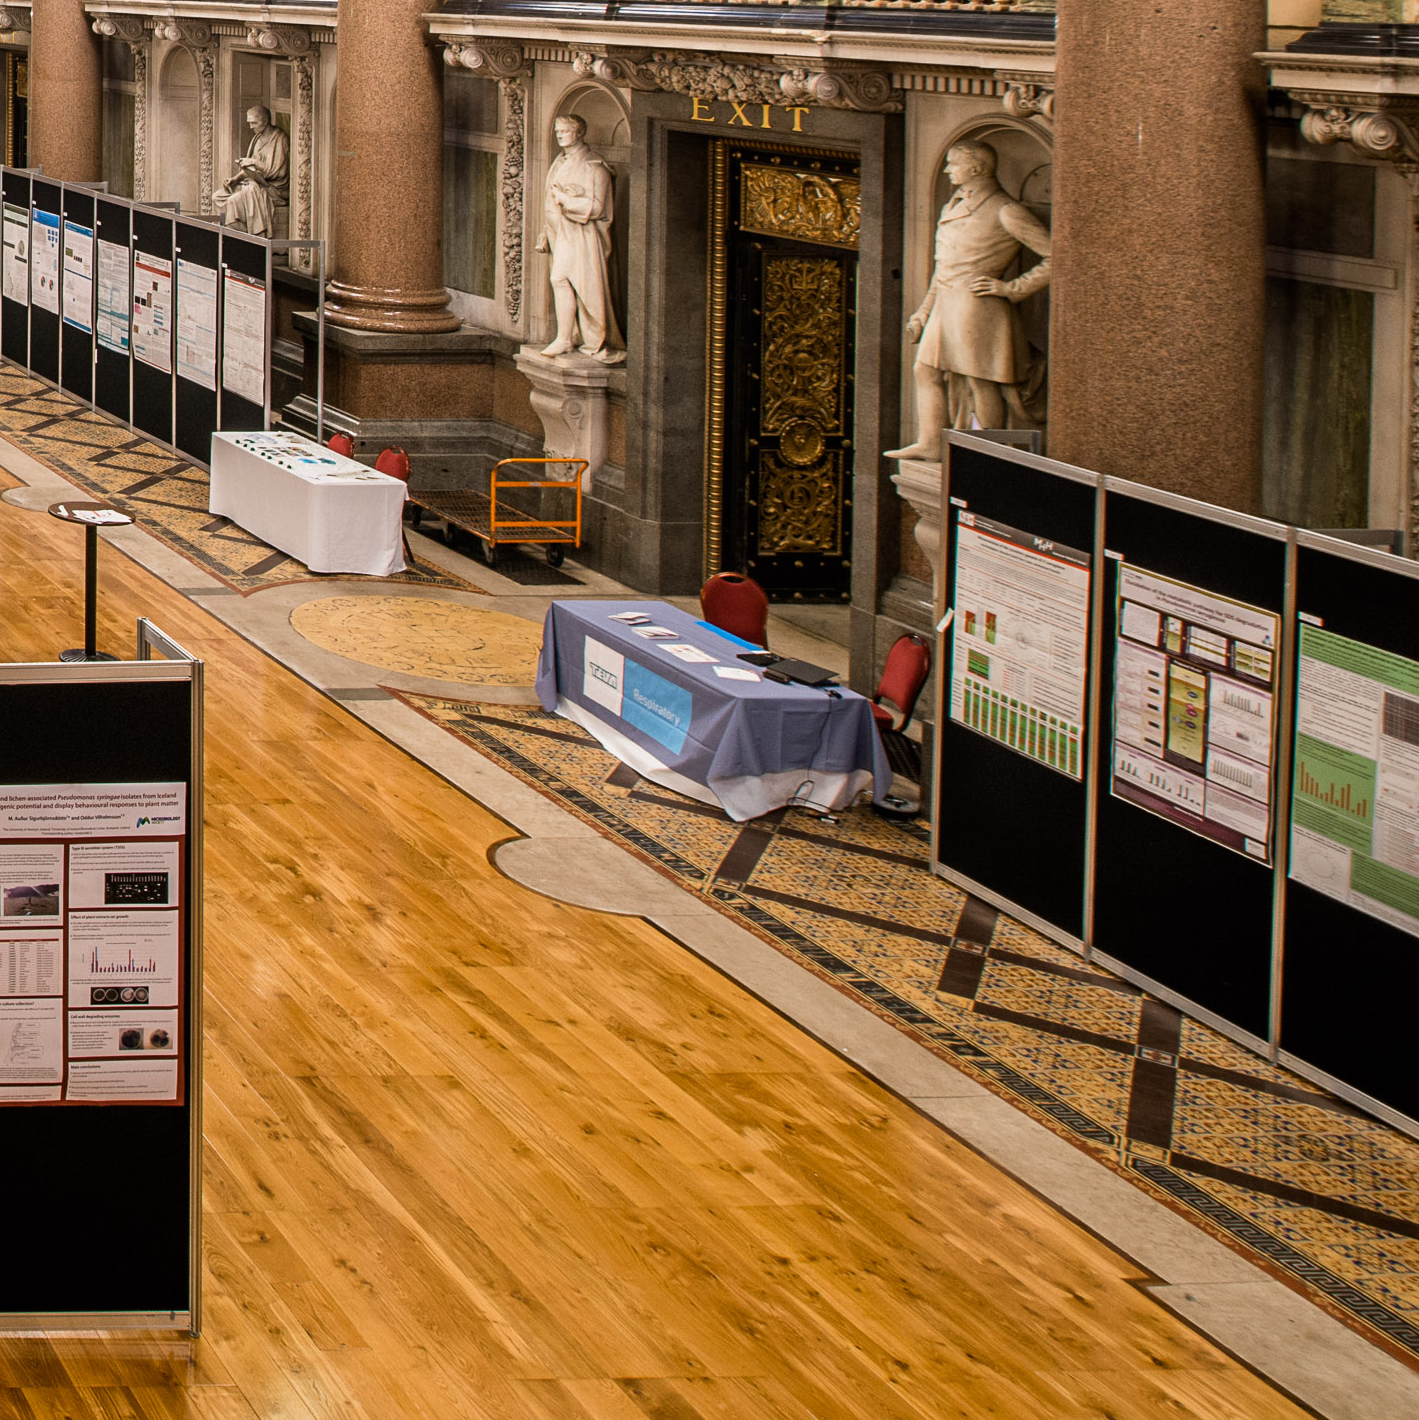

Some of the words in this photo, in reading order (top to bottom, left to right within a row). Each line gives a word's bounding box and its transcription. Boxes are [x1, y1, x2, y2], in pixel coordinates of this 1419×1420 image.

[691, 97, 810, 132] EXIT
[589, 661, 618, 690] TEVA
[633, 688, 681, 727] Respiratory
